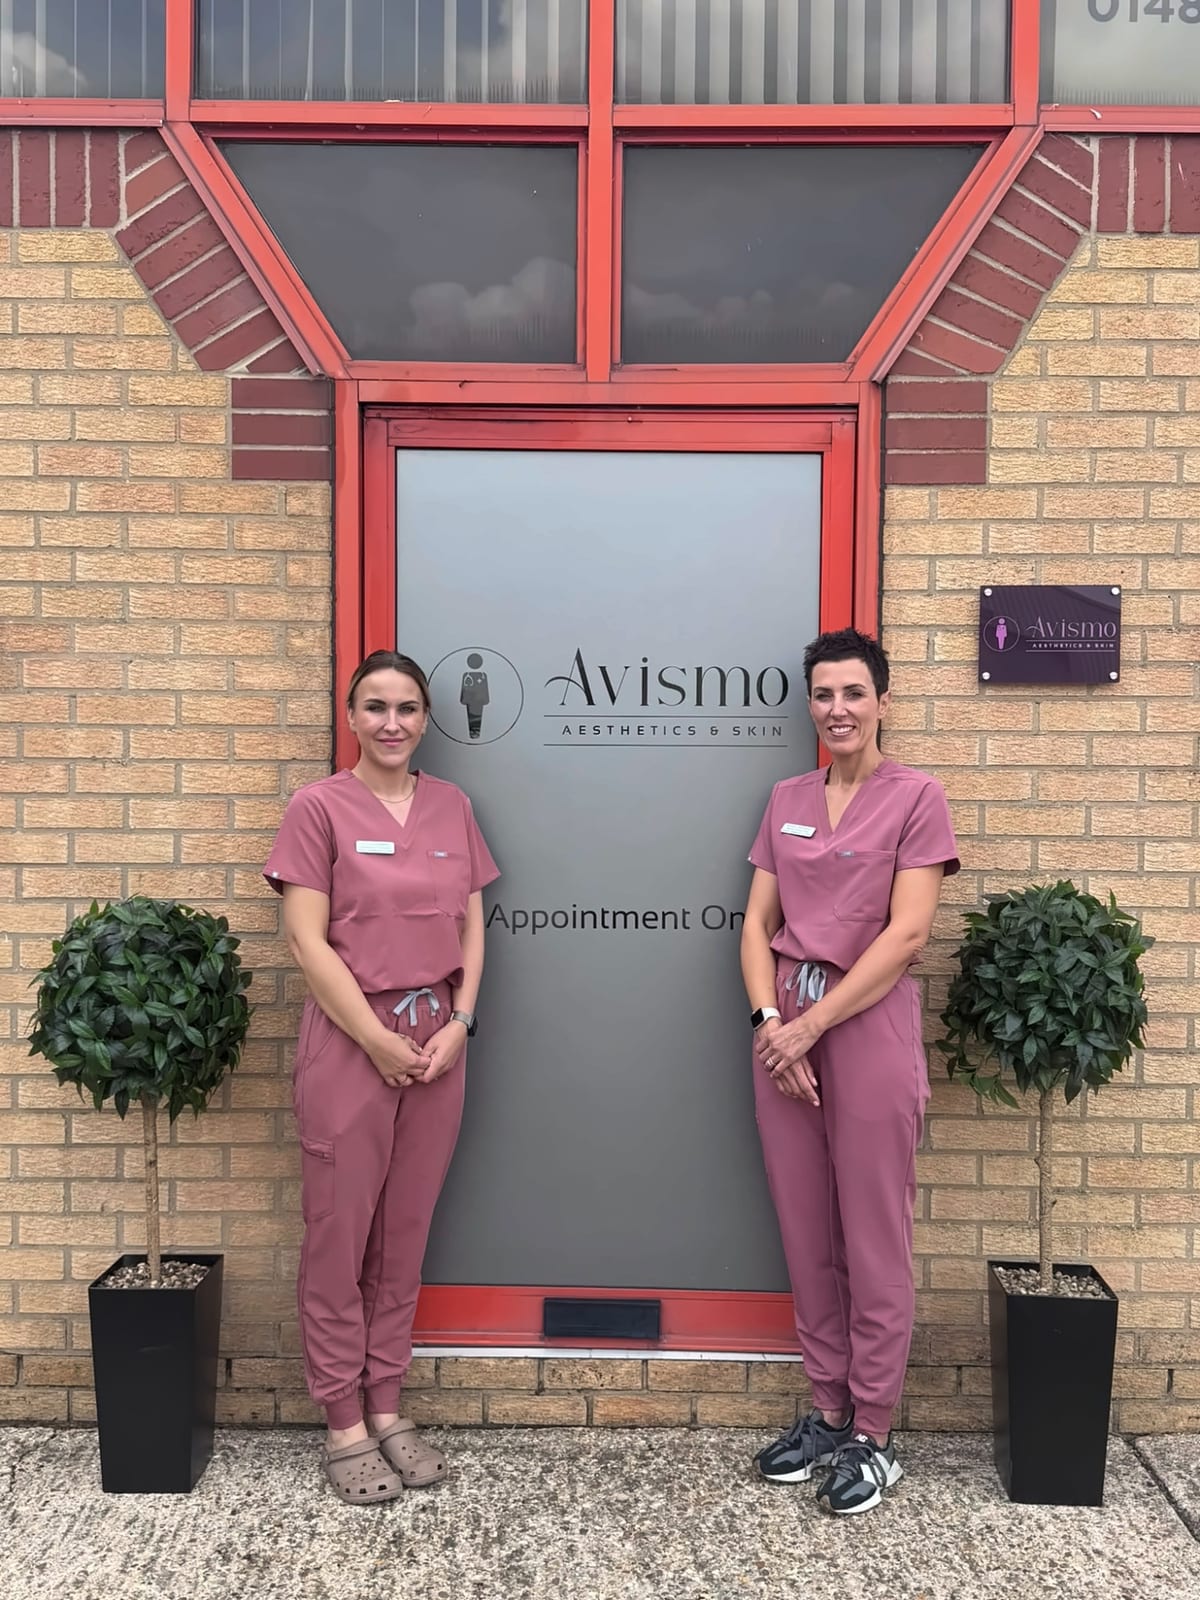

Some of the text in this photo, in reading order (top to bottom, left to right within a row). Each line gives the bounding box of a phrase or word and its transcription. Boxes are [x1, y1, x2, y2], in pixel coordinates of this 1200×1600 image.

[1025, 616, 1117, 638] Avismo
[544, 647, 789, 707] Avismo
[562, 724, 783, 737] AESTHETICS & SKIN
[486, 903, 691, 935] Appointment
